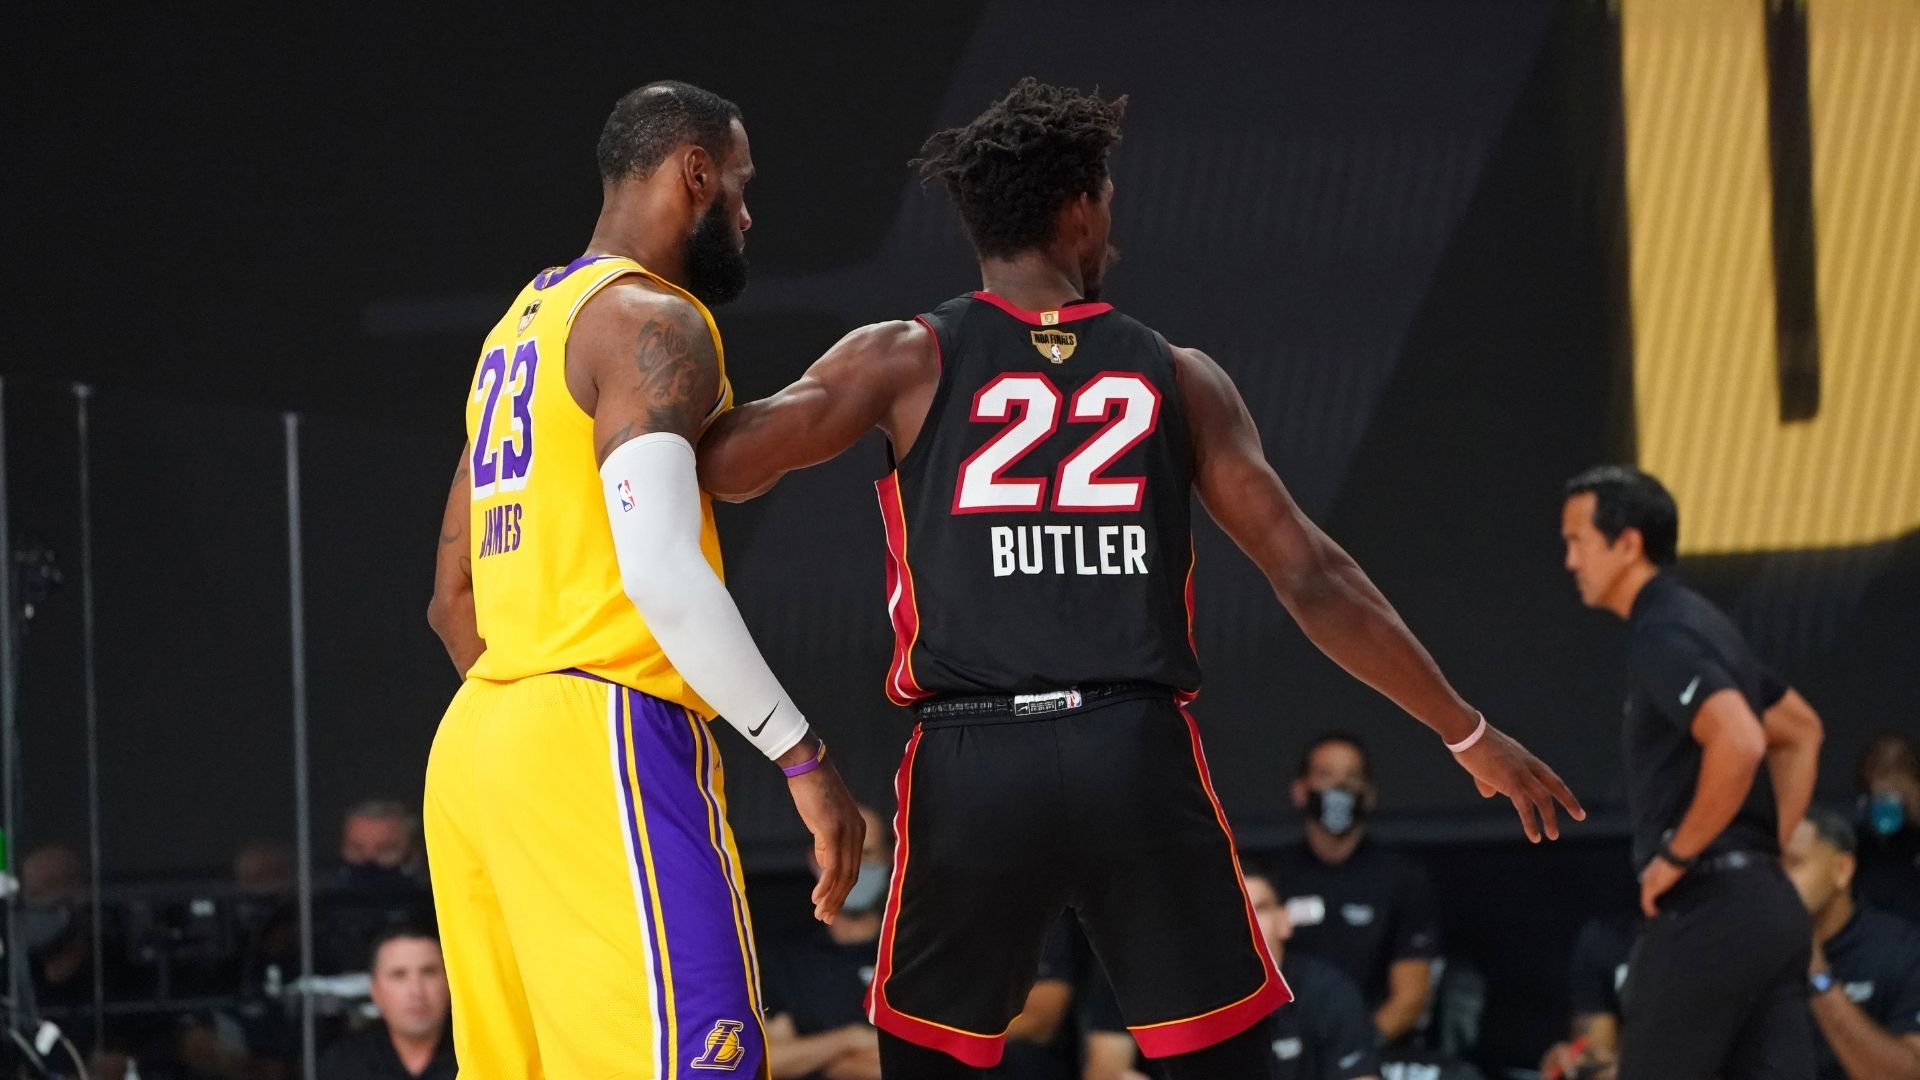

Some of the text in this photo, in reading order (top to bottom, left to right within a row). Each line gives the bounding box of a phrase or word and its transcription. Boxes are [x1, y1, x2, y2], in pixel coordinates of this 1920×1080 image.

[1034, 334, 1075, 346] NBA FINALS
[471, 337, 538, 499] 23
[951, 371, 1162, 515] 22
[479, 503, 522, 560] JAMES
[991, 525, 1149, 577] BUTLER
